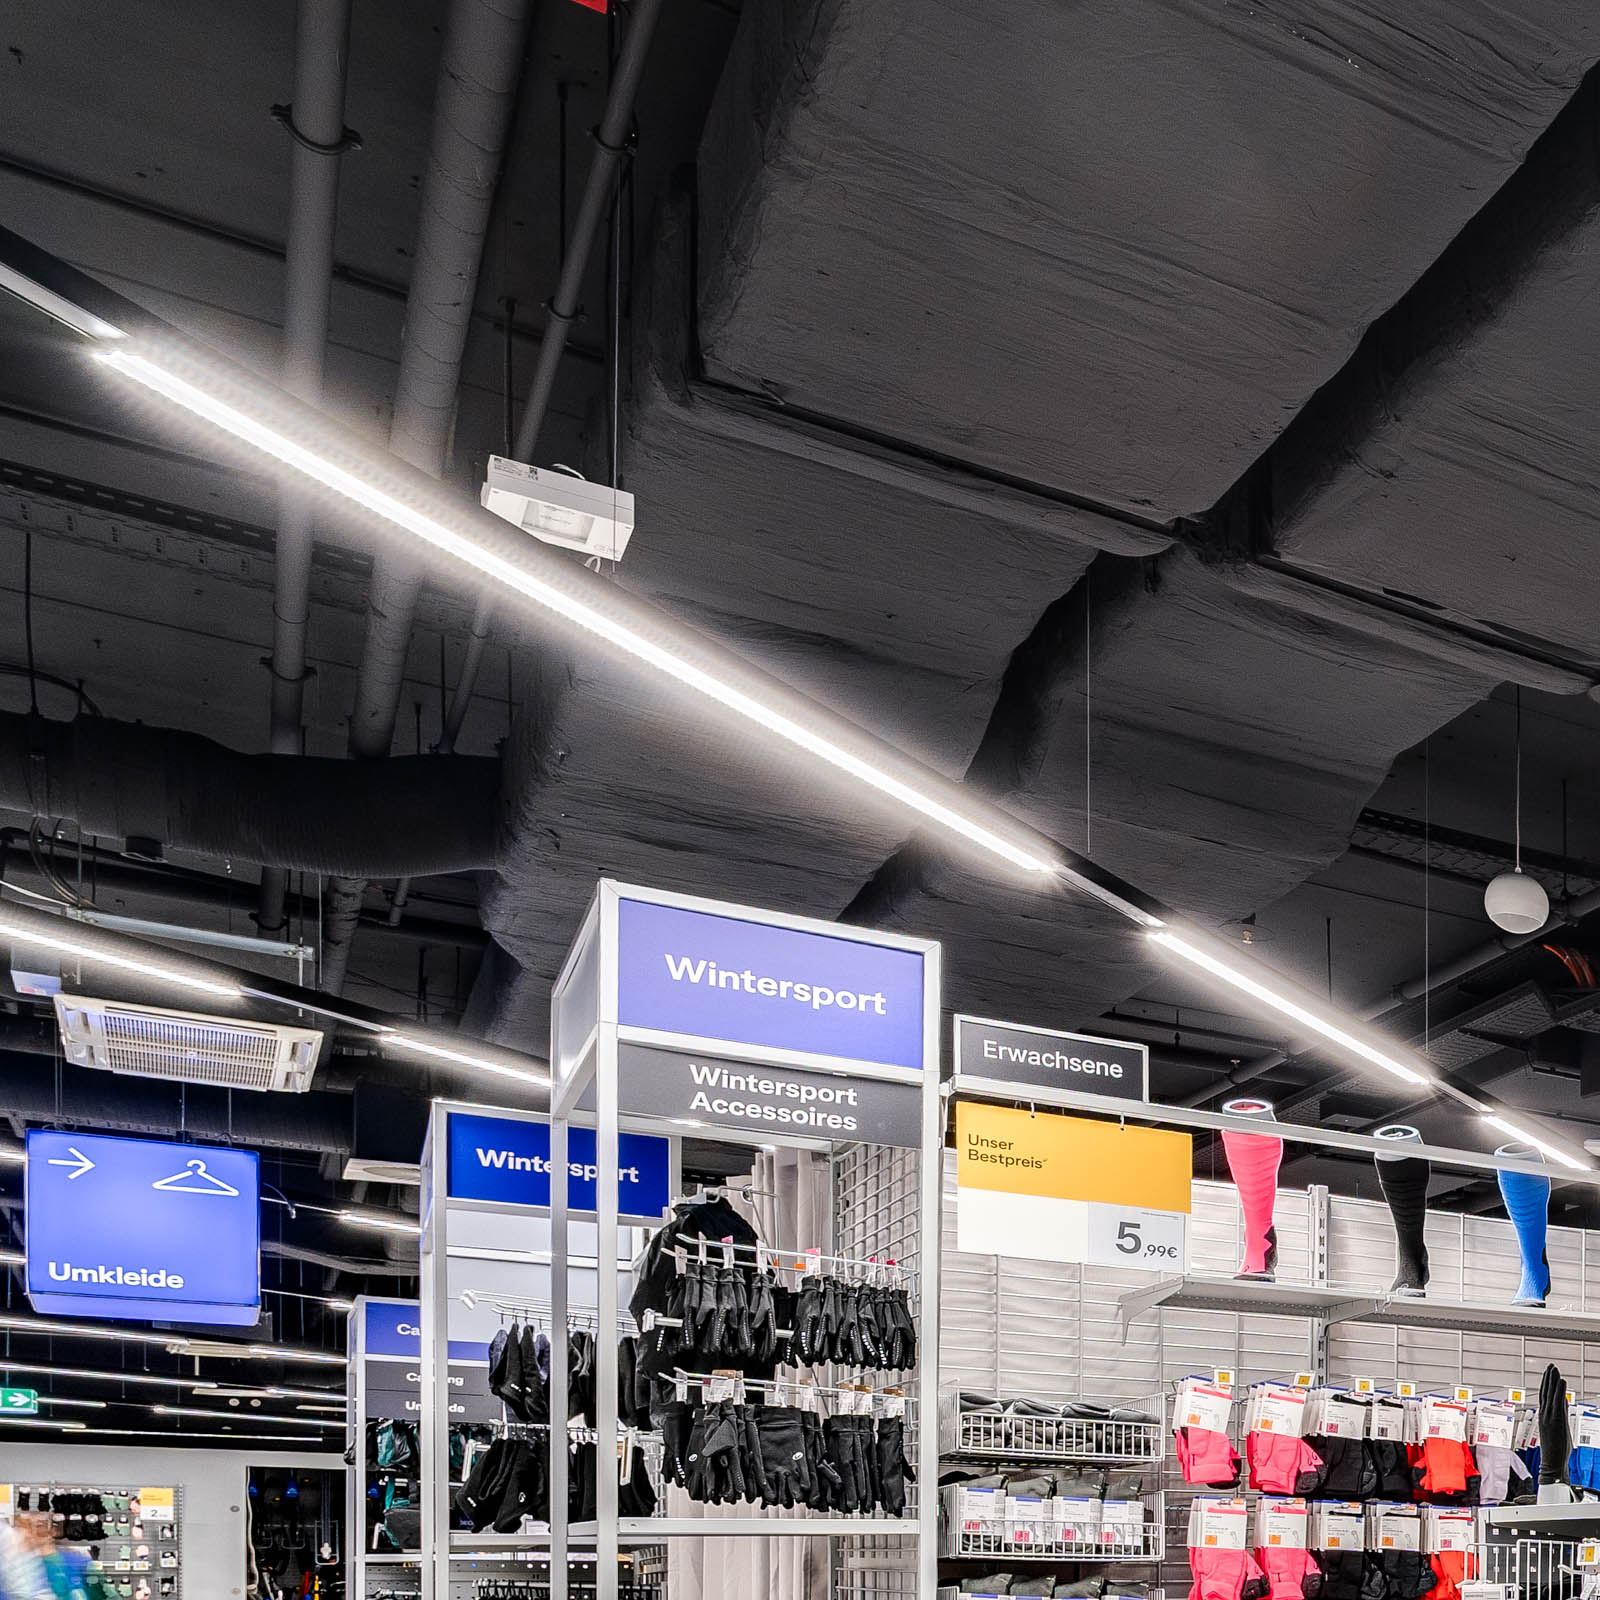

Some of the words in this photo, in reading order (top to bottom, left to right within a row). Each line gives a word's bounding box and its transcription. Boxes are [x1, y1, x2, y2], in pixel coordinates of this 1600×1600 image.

[664, 953, 886, 1015] Wintersport
[982, 1038, 1124, 1078] Erwachsene
[689, 1063, 858, 1106] Wintersport
[689, 1088, 858, 1131] Accessoires
[968, 1133, 1014, 1150] Unser
[968, 1149, 1043, 1169] Bestpreis
[475, 1148, 639, 1183] Wintesprt
[1115, 1221, 1178, 1258] 5,99€
[48, 1262, 184, 1289] Umkleide
